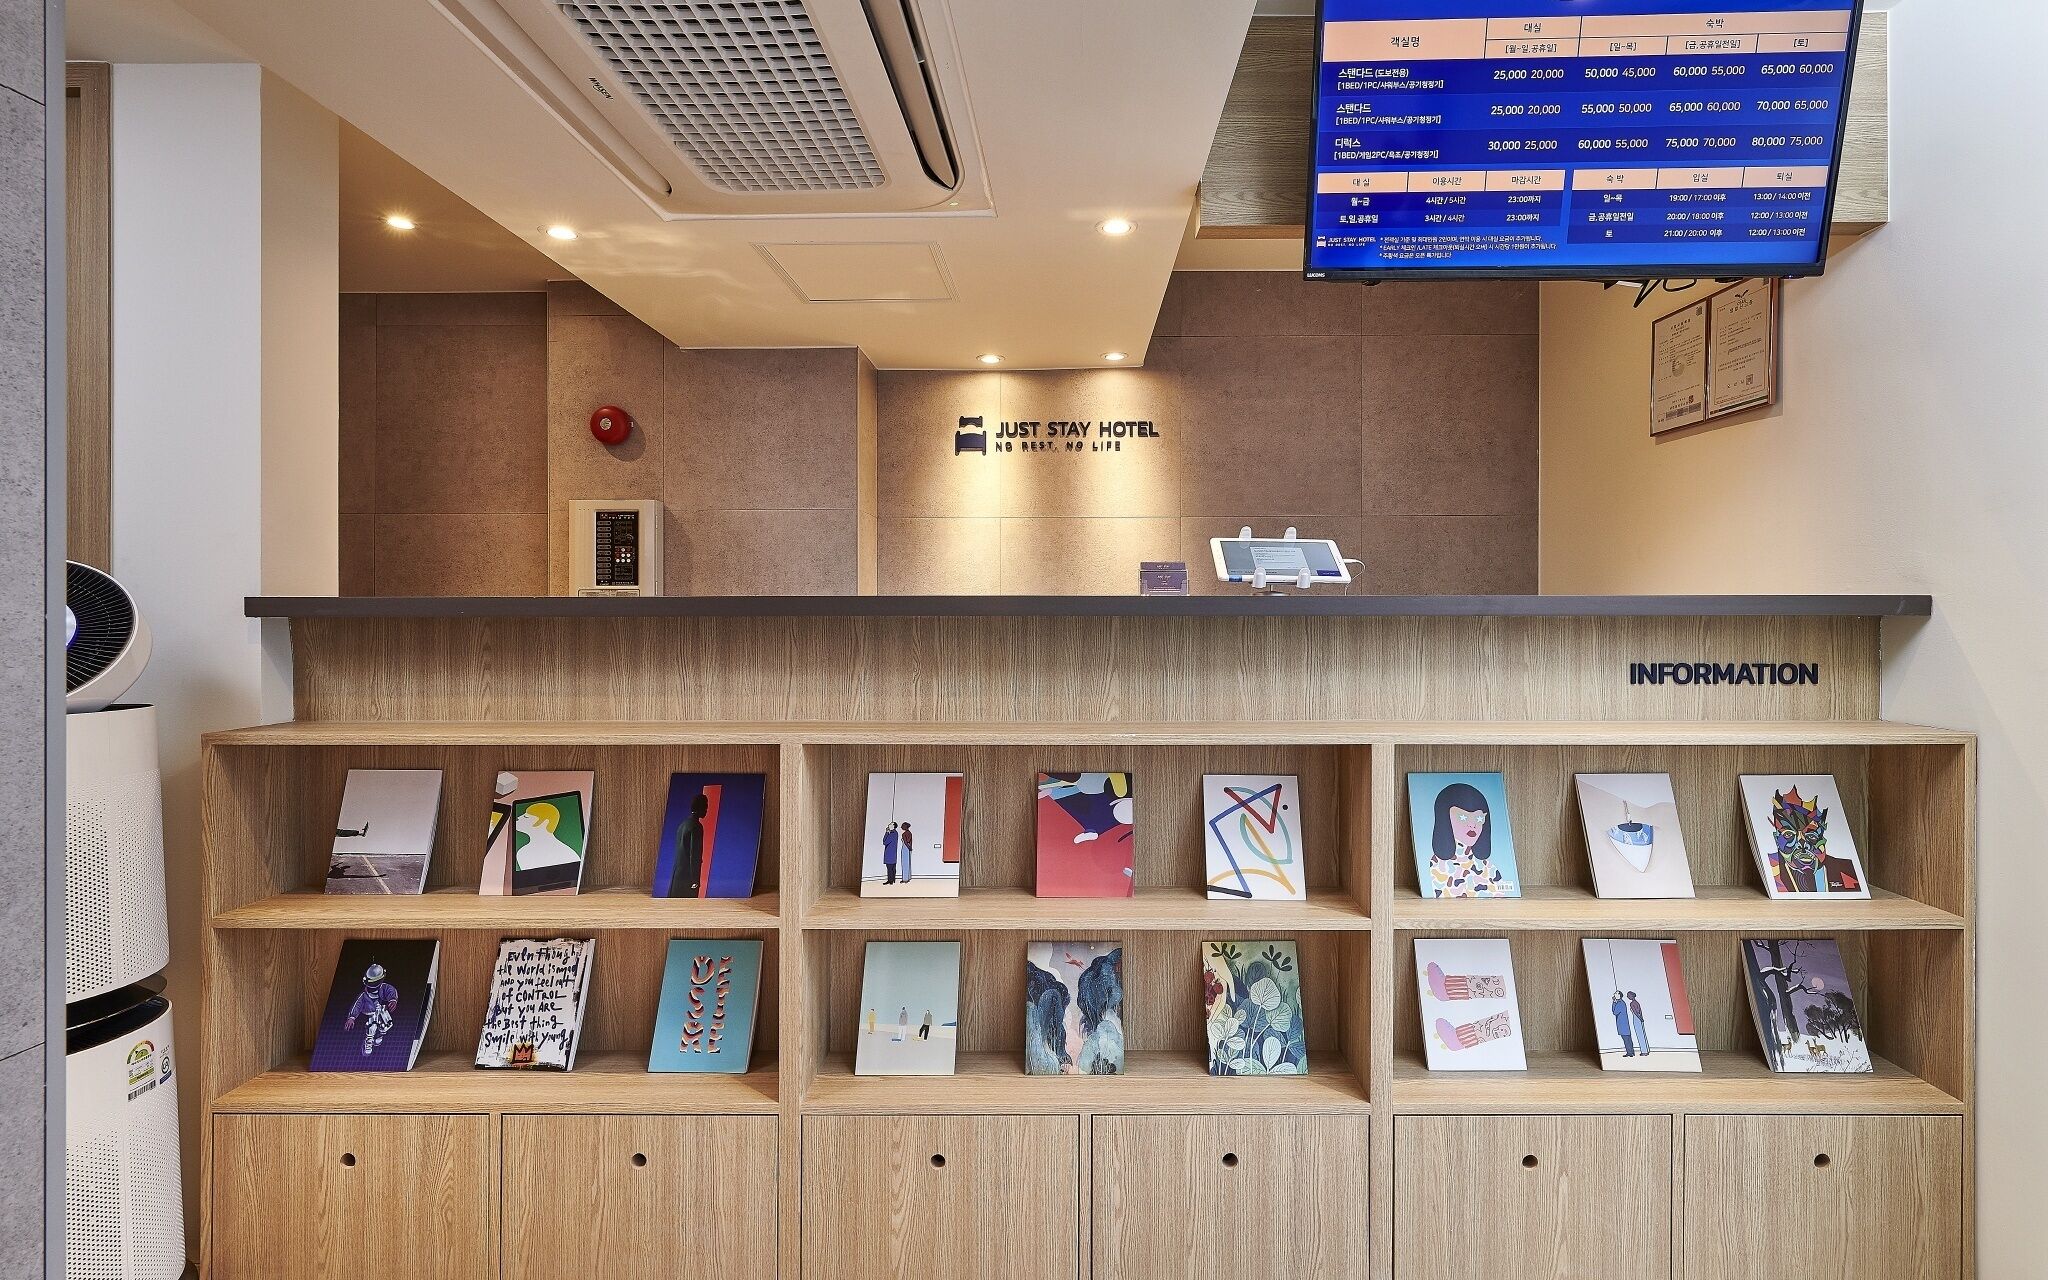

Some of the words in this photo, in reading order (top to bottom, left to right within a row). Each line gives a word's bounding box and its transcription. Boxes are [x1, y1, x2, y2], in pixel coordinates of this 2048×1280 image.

[1524, 22, 1542, 33] 대실
[1706, 18, 1724, 28] 숙박
[1390, 36, 1420, 48] 객실명
[1794, 38, 1808, 48] [토]
[1338, 68, 1374, 78] 스탠다드
[1375, 68, 1409, 78] (도보전용)
[1494, 70, 1527, 80] 25,000
[1530, 69, 1564, 80] 20,000
[1584, 68, 1618, 79] 50,000
[1622, 67, 1656, 78] 45,000
[1674, 66, 1707, 77] 60,000
[1711, 66, 1745, 76] 55,000
[1761, 64, 1795, 75] 65,000
[1799, 64, 1834, 74] 60,000
[1336, 103, 1372, 114] 스탠다드
[1490, 106, 1524, 116] 25,000
[1528, 105, 1560, 116] 20,000
[1582, 104, 1614, 114] 55,000
[1618, 103, 1652, 114] 50,000
[1670, 102, 1702, 113] 65,000
[1707, 102, 1740, 112] 60,000
[1756, 100, 1790, 112] 70,000
[1794, 100, 1828, 110] 65,000
[1335, 138, 1361, 148] 디럭스
[1488, 141, 1520, 152] 30,000
[1524, 140, 1558, 150] 25,000
[1578, 140, 1611, 150] 60,000
[1615, 139, 1648, 150] 55,000
[1666, 138, 1698, 148] 75,000
[1703, 138, 1736, 148] 70,000
[1752, 137, 1786, 147] 80,000
[1790, 136, 1823, 146] 75,000
[1432, 176, 1462, 186] 이용시간
[1512, 176, 1542, 184] 마감시간
[1508, 196, 1541, 204] 23:00까지
[1605, 230, 1613, 238] 토
[996, 422, 1040, 438] JUST
[1048, 422, 1091, 438] STAY
[1100, 421, 1160, 438] HOTEL
[996, 442, 1012, 452] NO
[1066, 441, 1084, 450] NO
[1092, 441, 1121, 451] LIFE
[1630, 662, 1818, 685] INFORMATION
[535, 976, 554, 988] feel
[502, 988, 514, 1004] of
[516, 988, 566, 1002] CONTROL
[518, 1004, 535, 1018] you
[485, 1018, 501, 1029] the
[530, 1015, 563, 1030] thing
[485, 1030, 514, 1050] Smile
[520, 1030, 538, 1044] with
